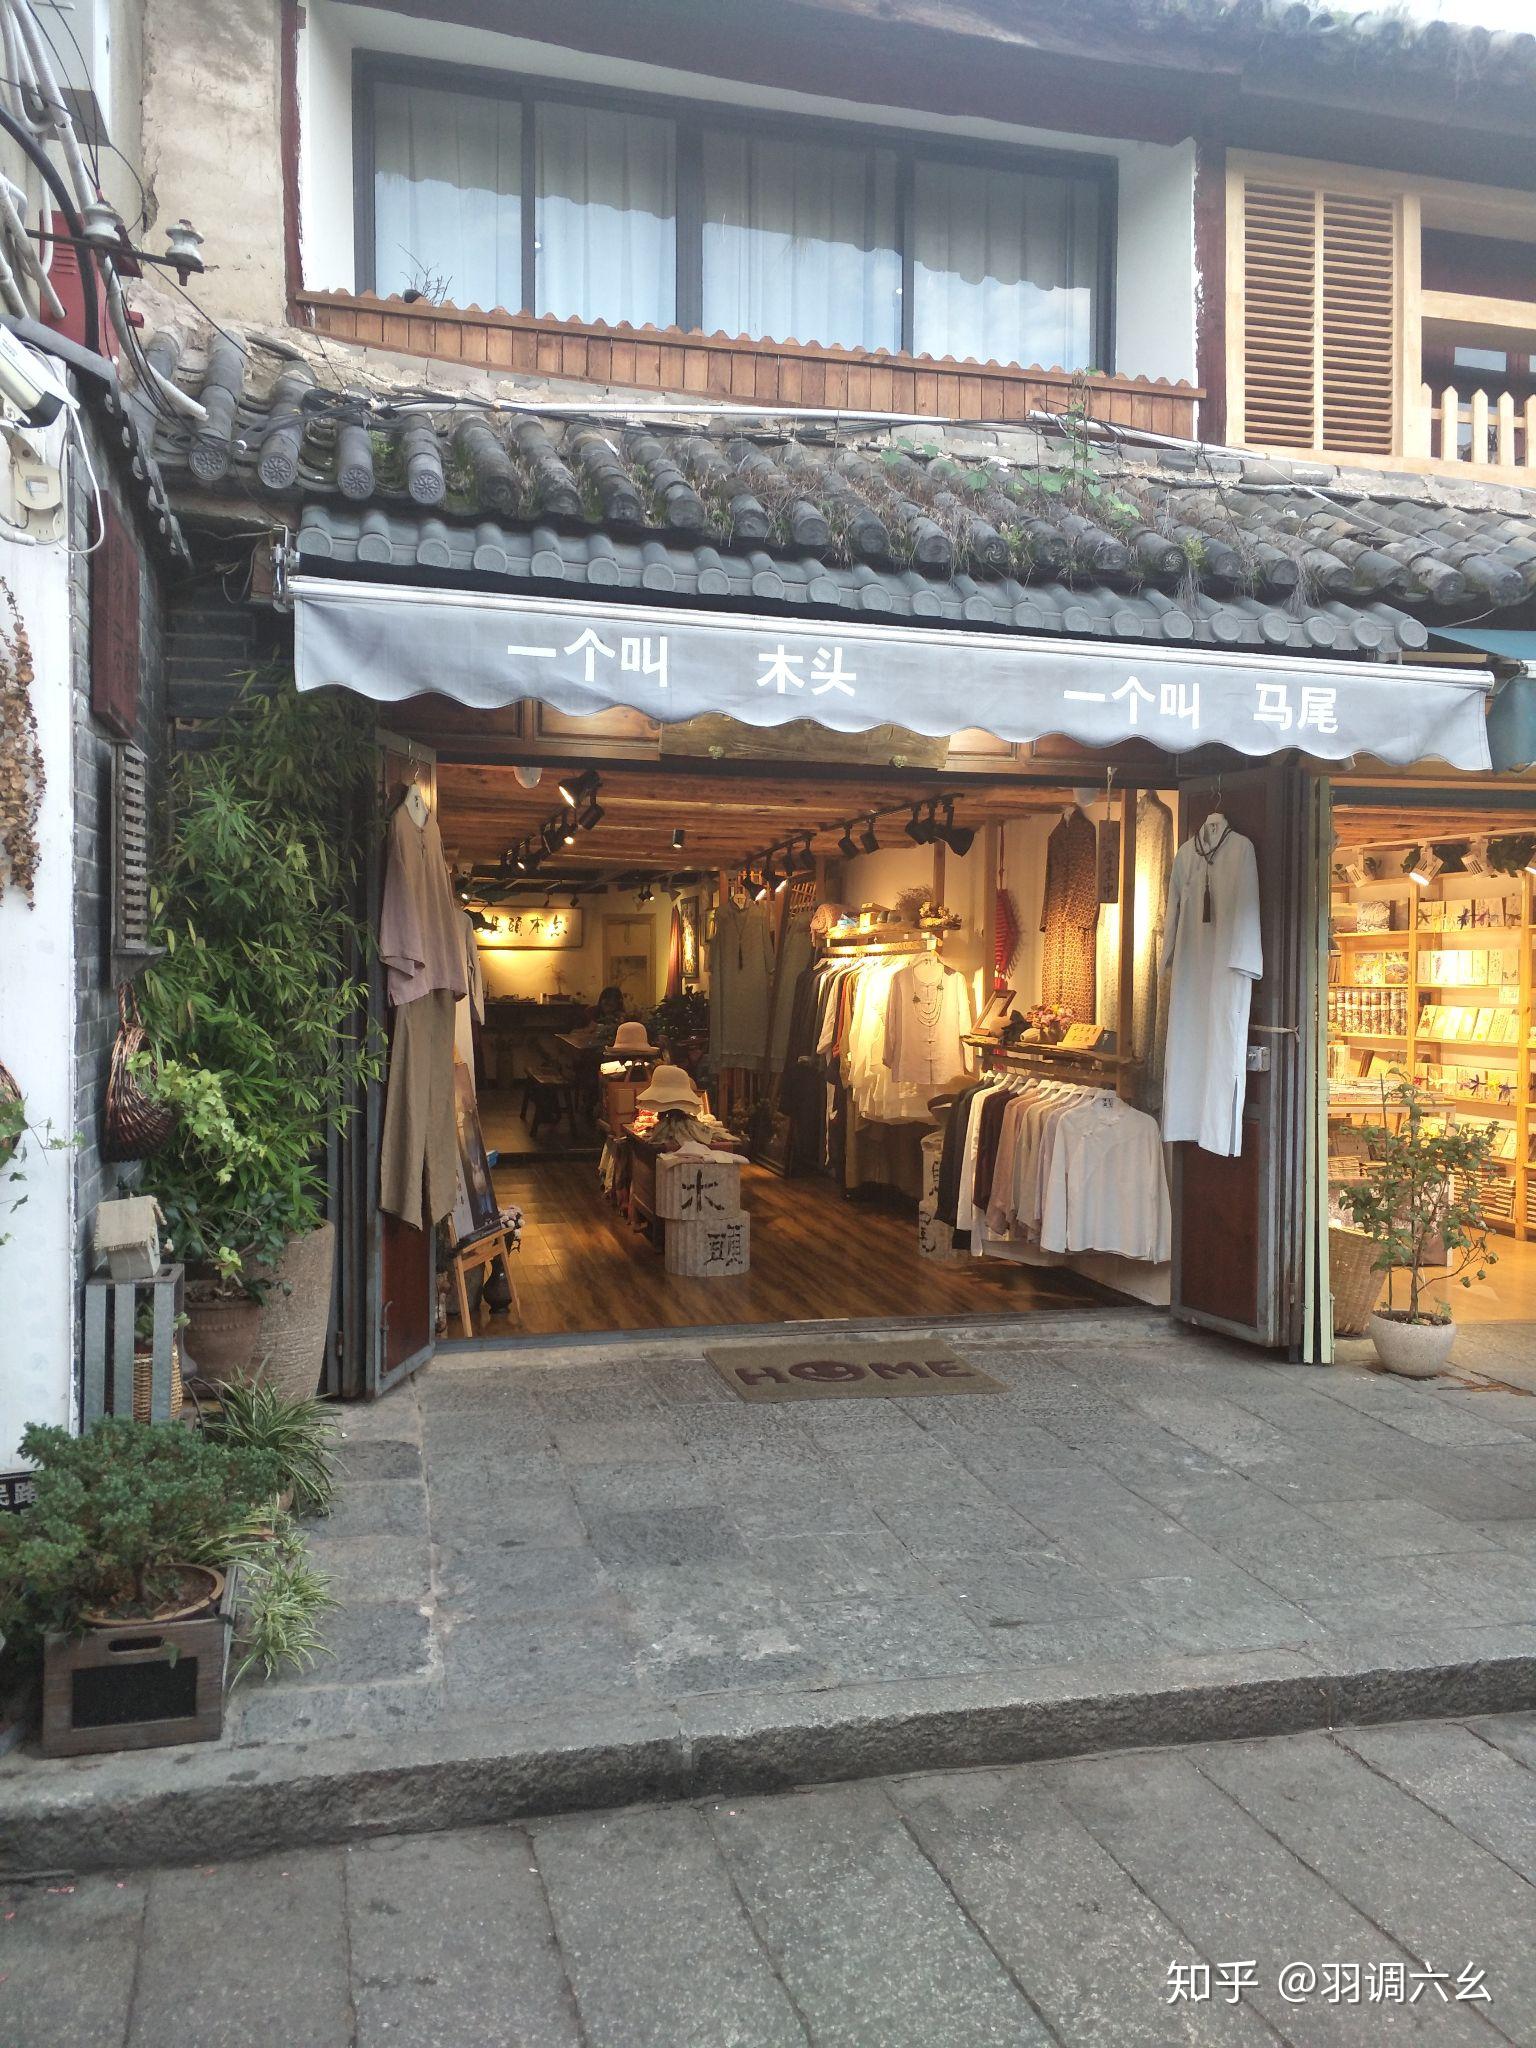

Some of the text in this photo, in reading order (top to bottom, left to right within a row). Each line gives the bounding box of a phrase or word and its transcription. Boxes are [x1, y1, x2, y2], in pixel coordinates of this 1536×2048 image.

[507, 628, 1339, 733] 一个叫 木头 一个叫 马尾
